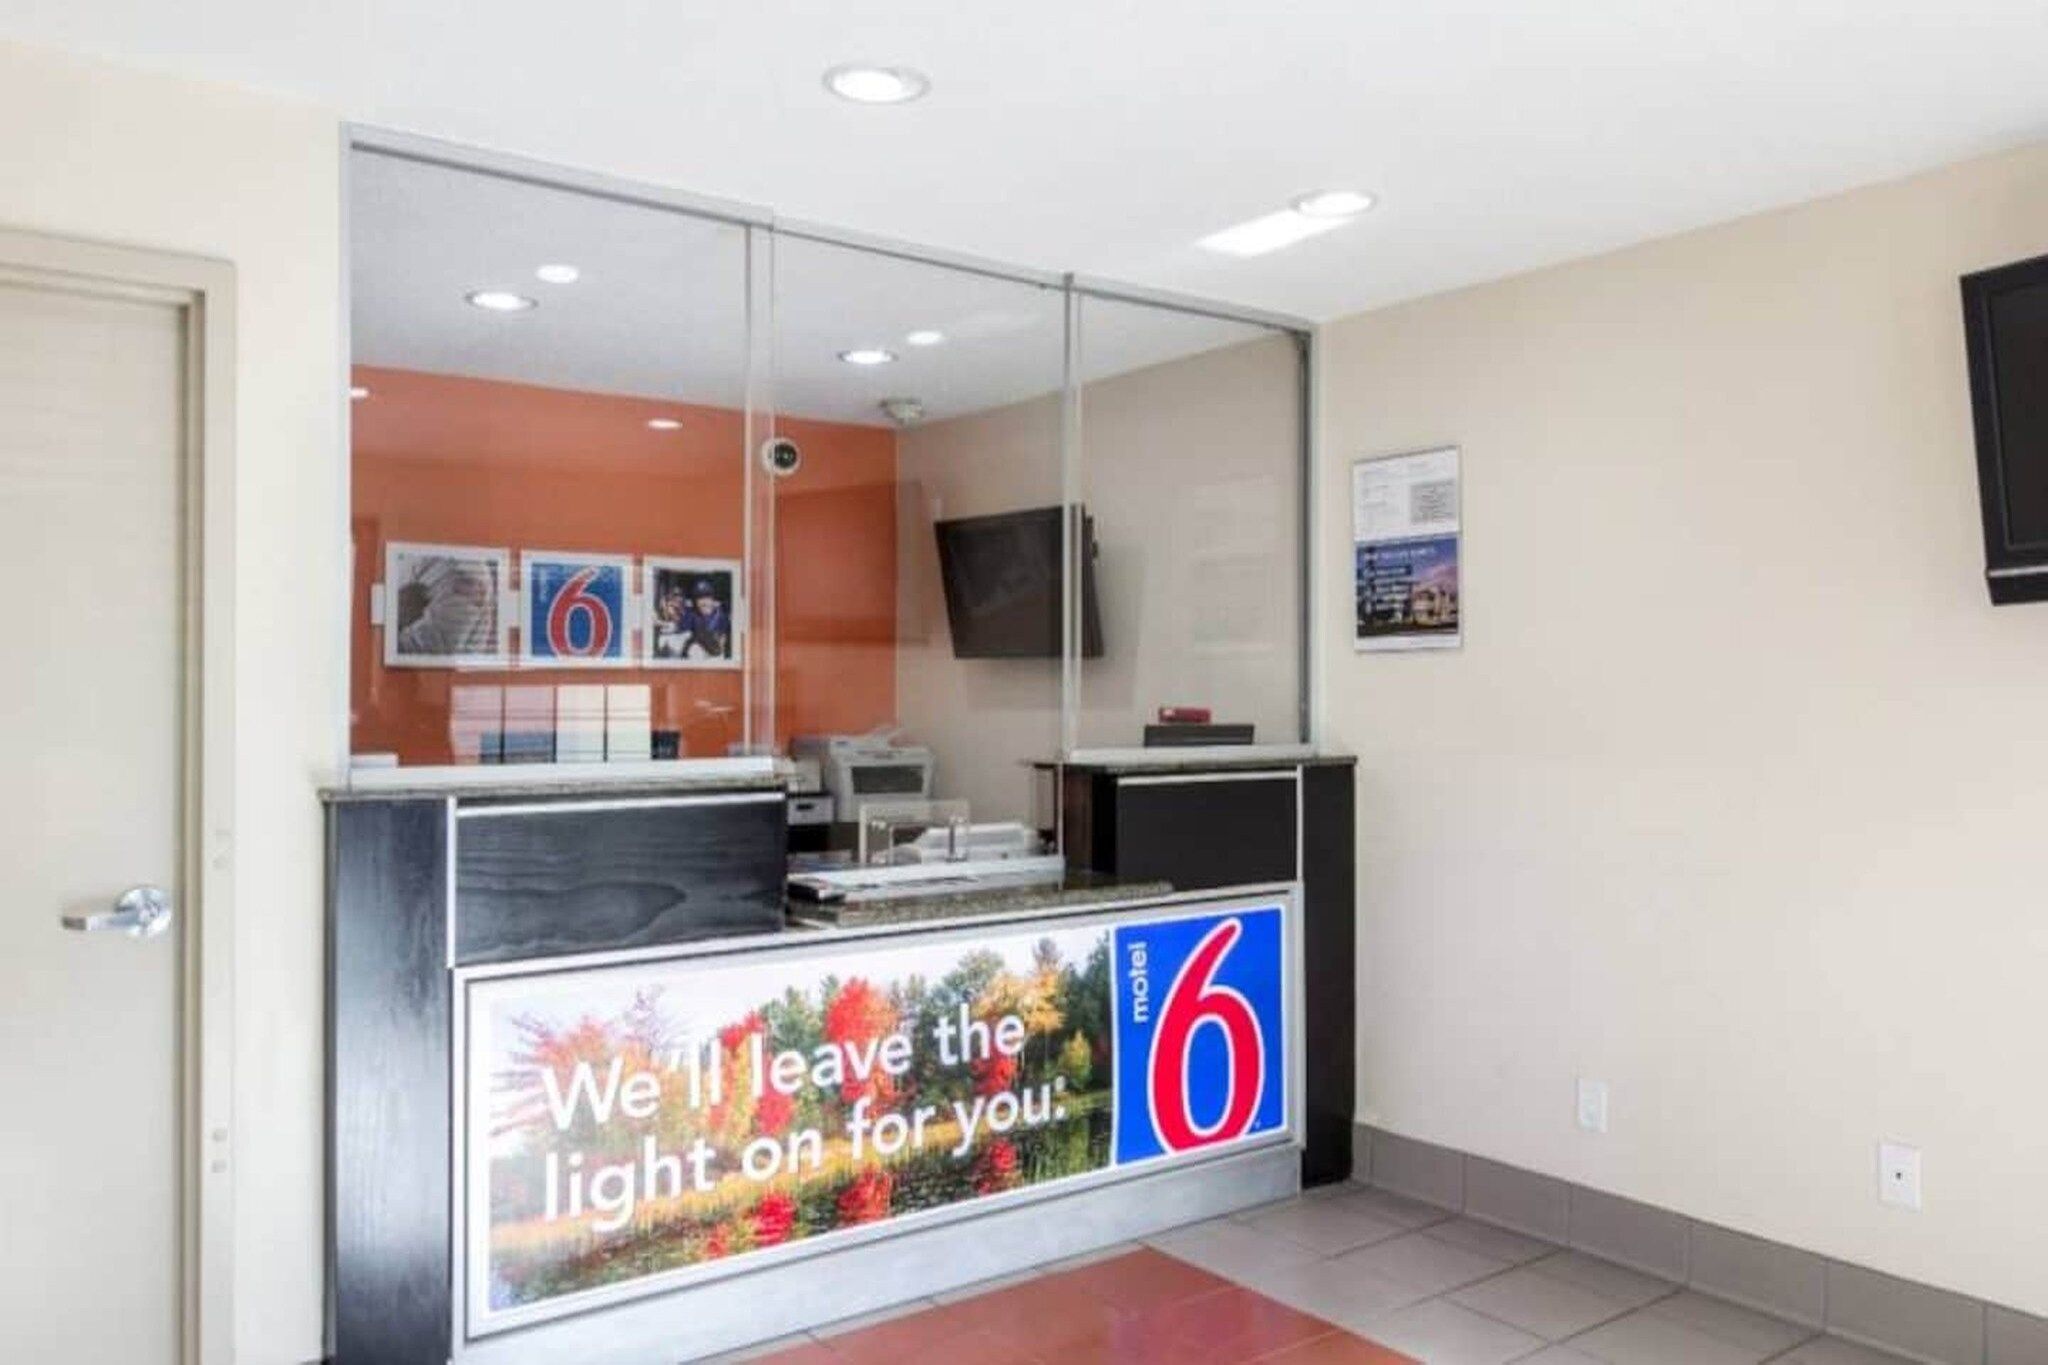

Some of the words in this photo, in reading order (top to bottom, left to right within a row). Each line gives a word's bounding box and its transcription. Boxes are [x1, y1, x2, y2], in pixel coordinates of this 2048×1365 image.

[547, 566, 612, 658] 6
[1127, 941, 1149, 1024] motel
[1147, 917, 1265, 1155] 6
[541, 1037, 721, 1130] We'll
[750, 1032, 912, 1098] leave
[933, 1002, 1025, 1066] the
[545, 1135, 717, 1232] light
[742, 1128, 822, 1182] on
[847, 1095, 936, 1161] for
